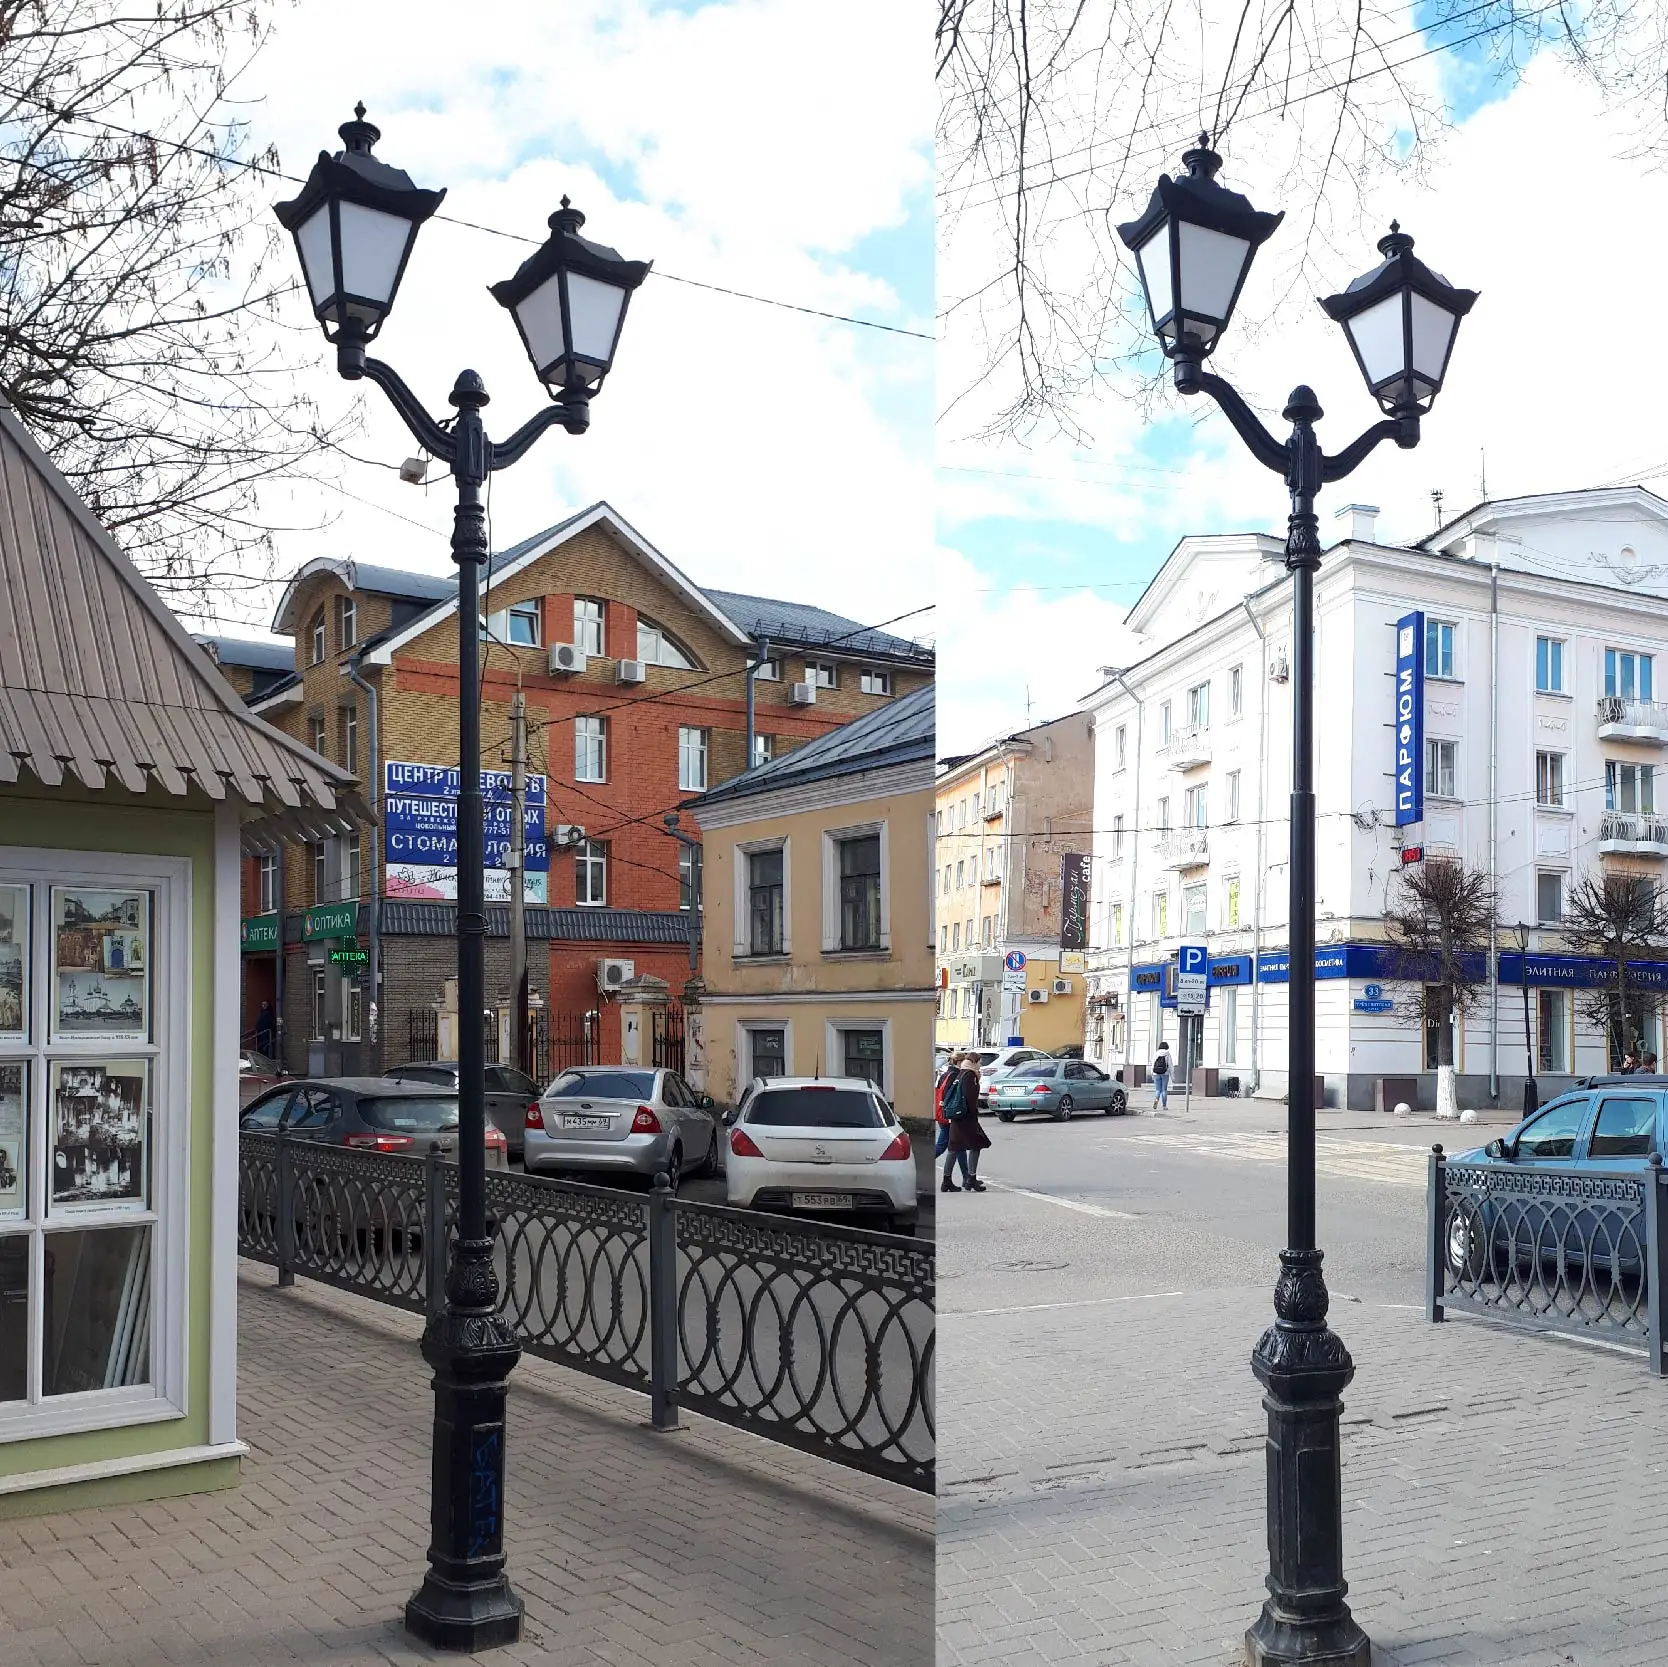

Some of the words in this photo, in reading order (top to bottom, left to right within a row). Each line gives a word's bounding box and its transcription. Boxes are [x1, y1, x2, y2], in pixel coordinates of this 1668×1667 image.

[1399, 668, 1412, 810] ПАРФЮМ
[392, 765, 443, 784] ЦЕНТР
[496, 807, 539, 824] ОТЫХ
[1079, 855, 1091, 883] cafe
[314, 913, 351, 931] ОПТИКА
[332, 952, 367, 961] АПТЕКА
[1185, 948, 1202, 971] P
[1525, 965, 1574, 978] ЭЛИТНАЯ
[1368, 987, 1379, 996] 33
